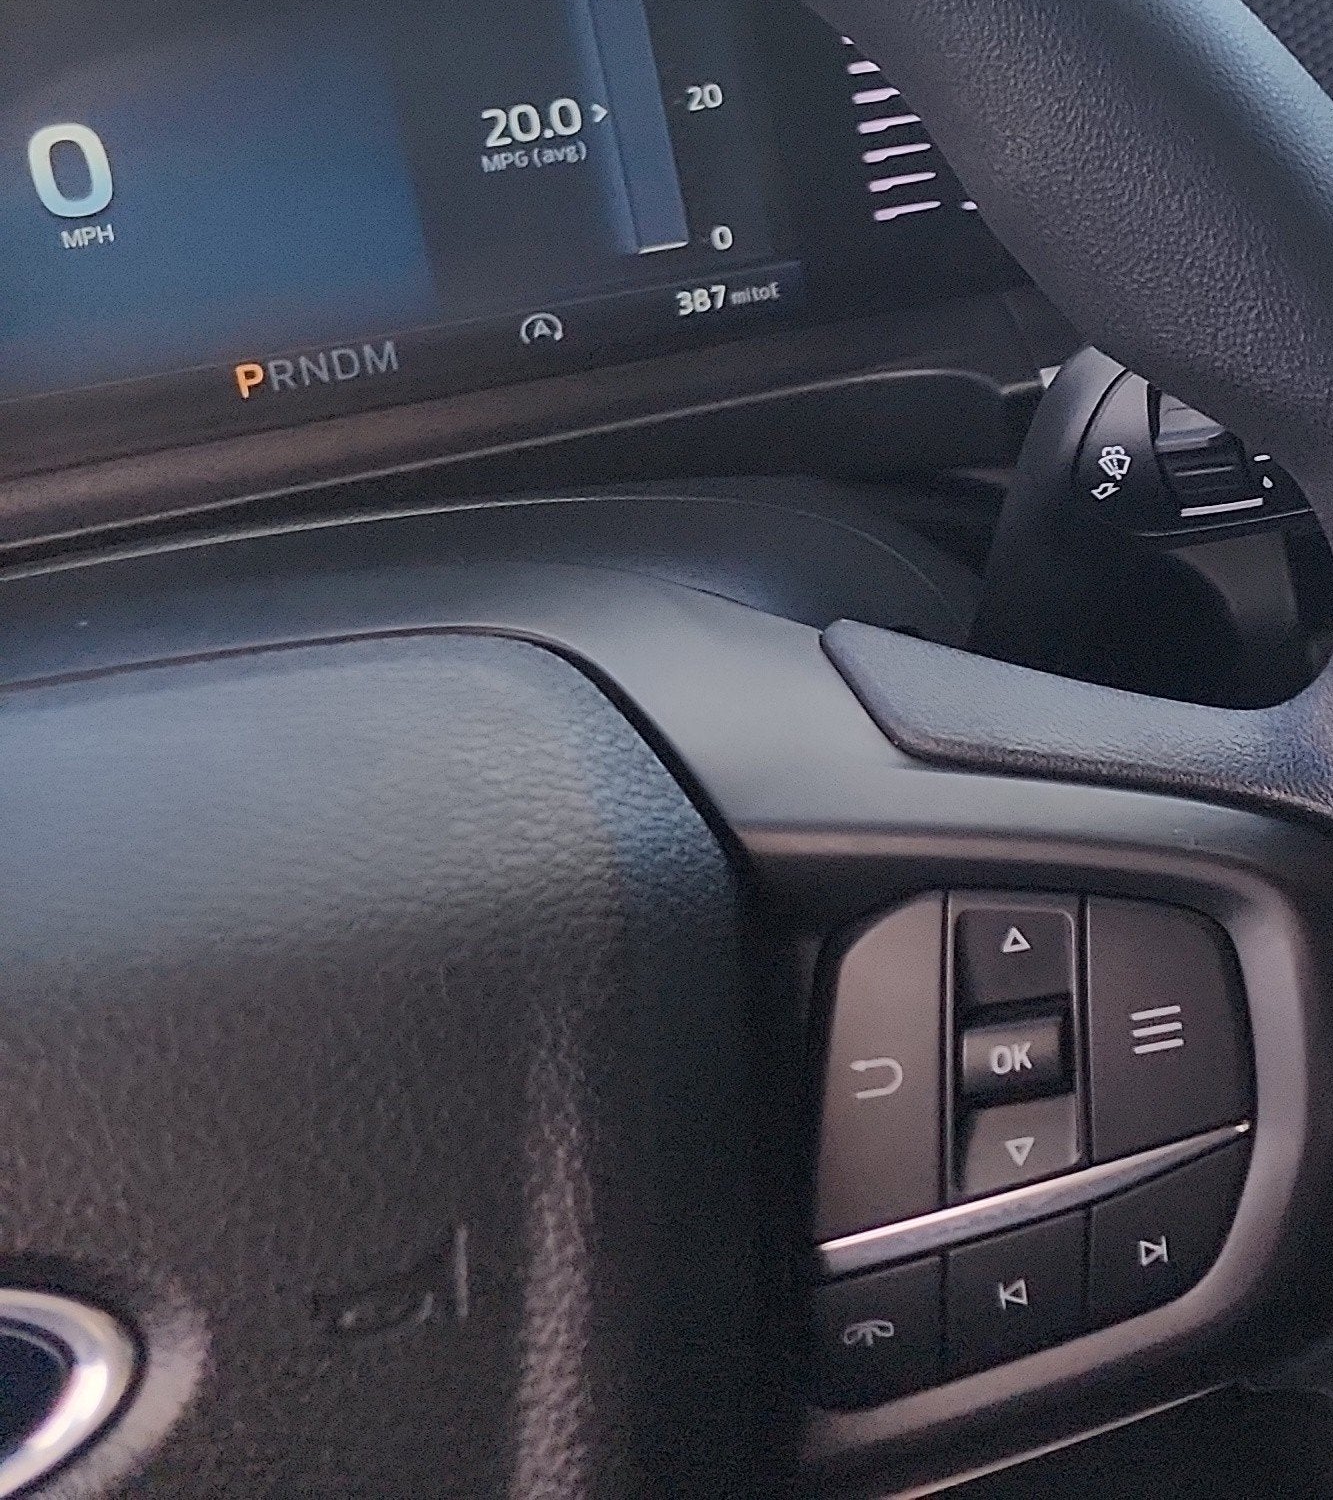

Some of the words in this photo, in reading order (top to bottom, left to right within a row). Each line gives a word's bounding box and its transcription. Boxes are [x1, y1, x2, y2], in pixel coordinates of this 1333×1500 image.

[686, 84, 723, 111] 20
[481, 97, 582, 148] 20.0
[26, 122, 114, 218] 0
[481, 149, 529, 173] MPG
[533, 140, 588, 169] (avg)
[61, 223, 115, 250] MPH
[710, 225, 733, 251] 0
[676, 285, 726, 316] 387
[989, 1042, 1032, 1075] OK
